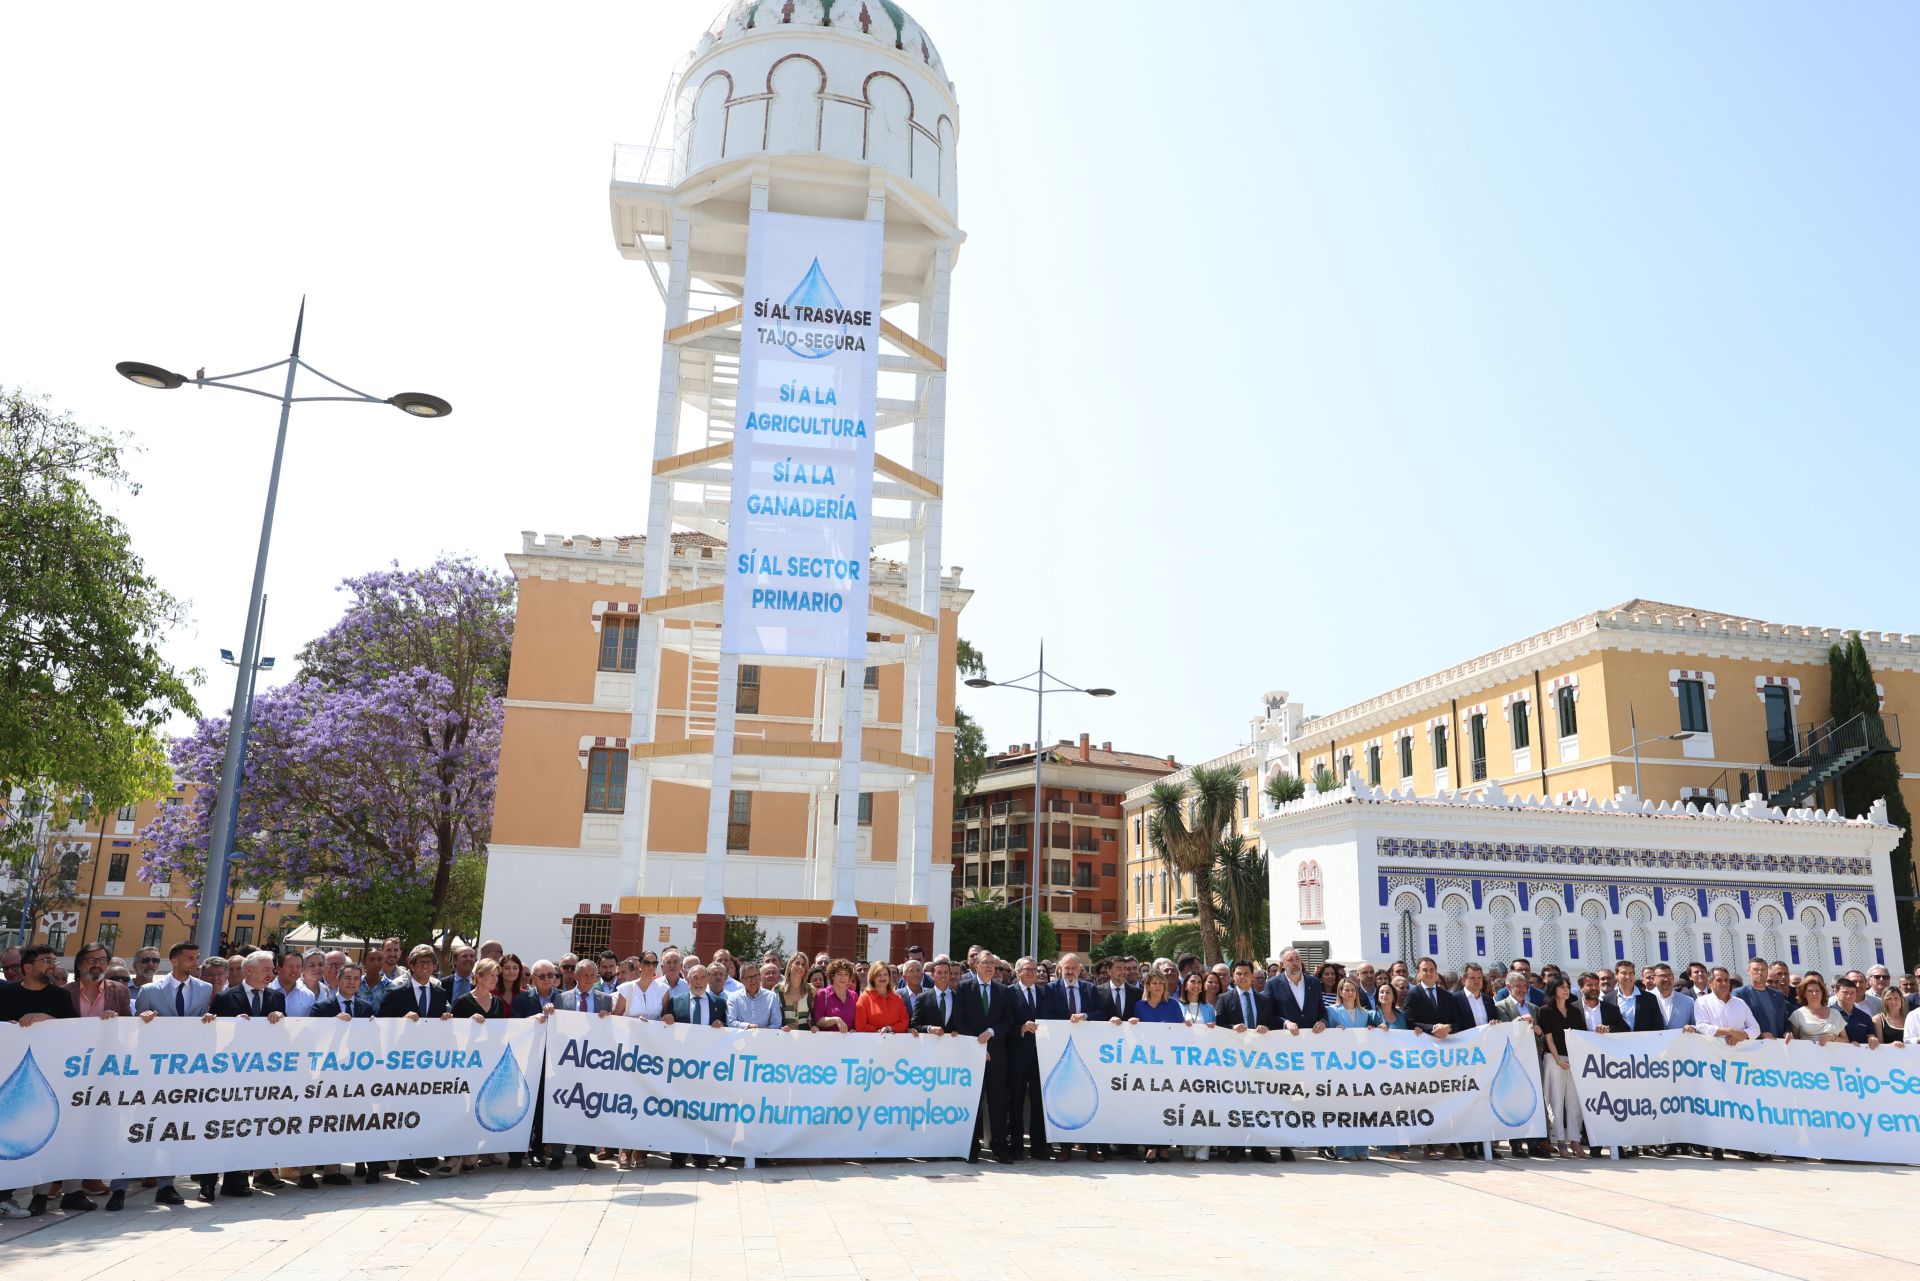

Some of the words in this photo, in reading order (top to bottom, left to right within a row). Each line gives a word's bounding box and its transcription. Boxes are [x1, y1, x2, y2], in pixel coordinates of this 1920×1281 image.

[754, 298, 769, 318] SÍ
[771, 304, 790, 320] AL
[795, 306, 872, 326] TRASVASE
[758, 328, 866, 351] TAJO-SEGURA
[780, 379, 797, 402] SÍ
[799, 386, 811, 404] A
[815, 387, 837, 405] LA
[745, 411, 867, 438] AGRICULTURA
[773, 457, 792, 482] SÍ
[794, 464, 807, 483] A
[812, 465, 835, 485] LA
[747, 494, 857, 520] GANADERÍA
[738, 548, 757, 574] SÍ
[759, 555, 782, 576] AL
[787, 556, 860, 580] SECTOR
[752, 589, 843, 613] PRIMARIO
[64, 1048, 95, 1078] SÍ
[97, 1054, 139, 1076] AL
[150, 1051, 299, 1075] TRASVASE
[308, 1050, 483, 1072] TAJO-SEGURA
[557, 1039, 664, 1076] Alcaldes
[666, 1057, 711, 1083] por
[712, 1053, 735, 1082] el
[739, 1055, 837, 1085] Trasvase
[841, 1058, 971, 1092] Tajo-Segura
[1098, 1038, 1125, 1064] SÍ
[1130, 1044, 1164, 1065] AL
[1171, 1046, 1305, 1071] TRASVASE
[1311, 1046, 1487, 1071] TAJO-SEGURA
[1110, 1073, 1128, 1091] SÍ
[1132, 1077, 1145, 1092] A
[1150, 1078, 1174, 1093] LA
[1179, 1079, 1310, 1098] AGRICULTURA,
[1315, 1080, 1332, 1097] SÍ
[1335, 1083, 1349, 1097] A
[1353, 1083, 1375, 1097] LA
[1379, 1075, 1480, 1096] GANADERÍA
[1582, 1053, 1670, 1080] Alcaldes
[1672, 1058, 1707, 1083] por
[1710, 1059, 1727, 1083] el
[1730, 1061, 1830, 1091] Trasvase
[71, 1086, 95, 1107] SÍ
[96, 1090, 112, 1106] A
[118, 1089, 146, 1106] LA
[151, 1085, 299, 1104] AGRICULTURA,
[304, 1081, 324, 1099] SÍ
[325, 1084, 338, 1098] A
[343, 1084, 365, 1098] LA
[370, 1077, 470, 1097] GANADERÍA
[552, 1082, 638, 1120] «Agua,
[643, 1095, 756, 1124] consumo
[759, 1096, 854, 1125] humano
[856, 1105, 871, 1131] y
[874, 1098, 970, 1131] empleo»
[127, 1117, 157, 1144] SÍ
[159, 1121, 196, 1142] AL
[204, 1116, 303, 1140] SECTOR
[308, 1111, 421, 1134] PRIMARIO
[1162, 1104, 1186, 1127] SÍ
[1190, 1109, 1221, 1127] AL
[1228, 1110, 1316, 1129] SECTOR
[1322, 1108, 1435, 1128] PRIMARIO
[1585, 1091, 1657, 1122] «Agua,
[1660, 1095, 1754, 1122] consumo
[1756, 1098, 1856, 1130] humano
[1857, 1113, 1872, 1137] y
[1877, 1113, 1920, 1133] em
